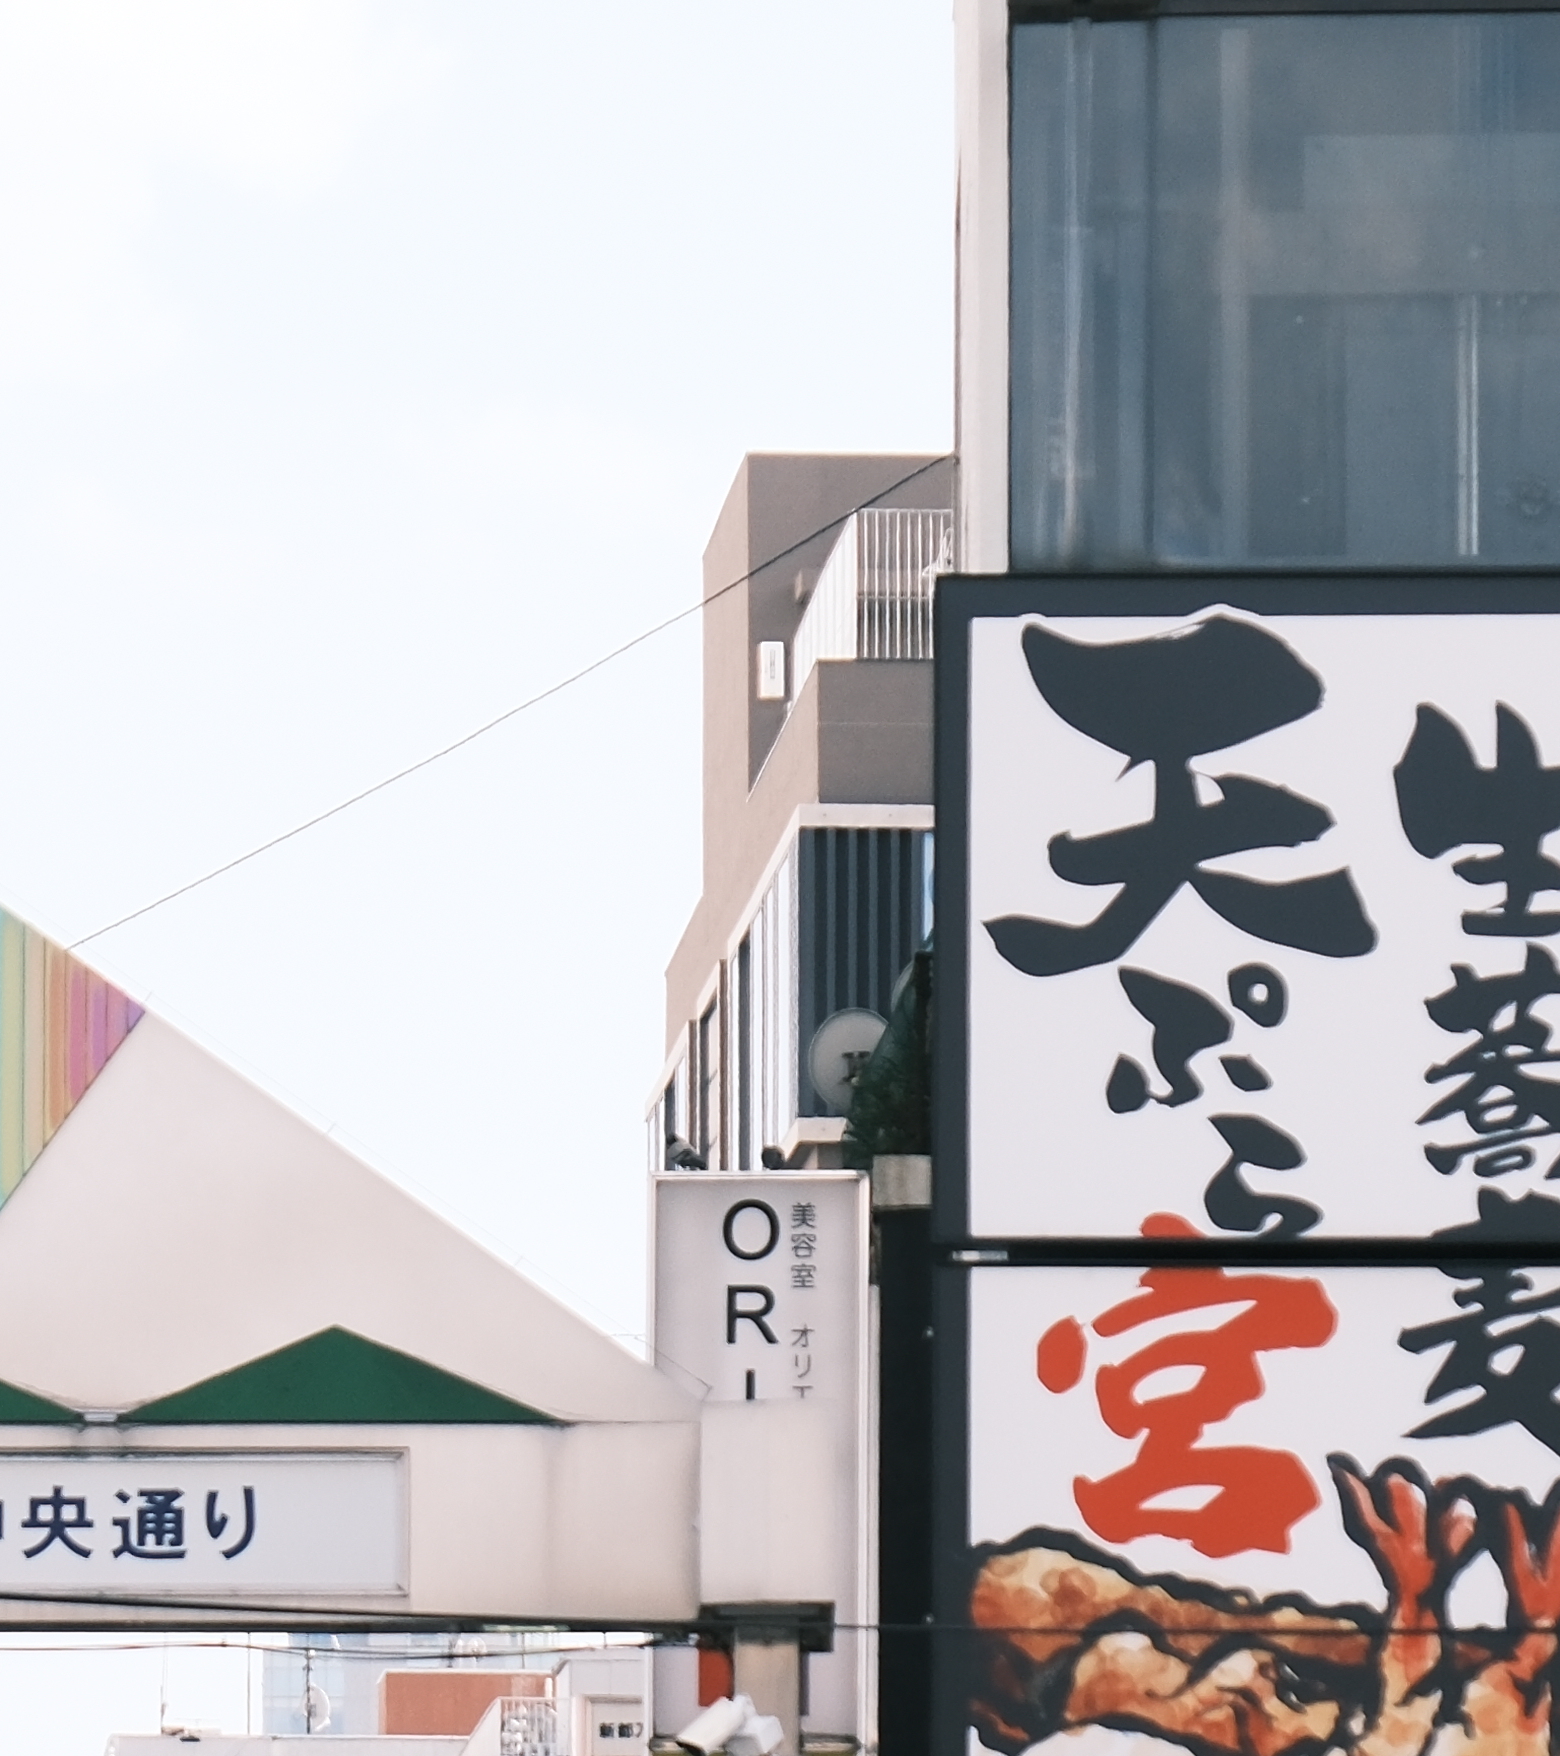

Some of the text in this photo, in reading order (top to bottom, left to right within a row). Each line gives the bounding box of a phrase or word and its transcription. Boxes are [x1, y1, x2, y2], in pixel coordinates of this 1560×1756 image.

[791, 1202, 817, 1289] 美容室
[1036, 1213, 1338, 1557] 宮
